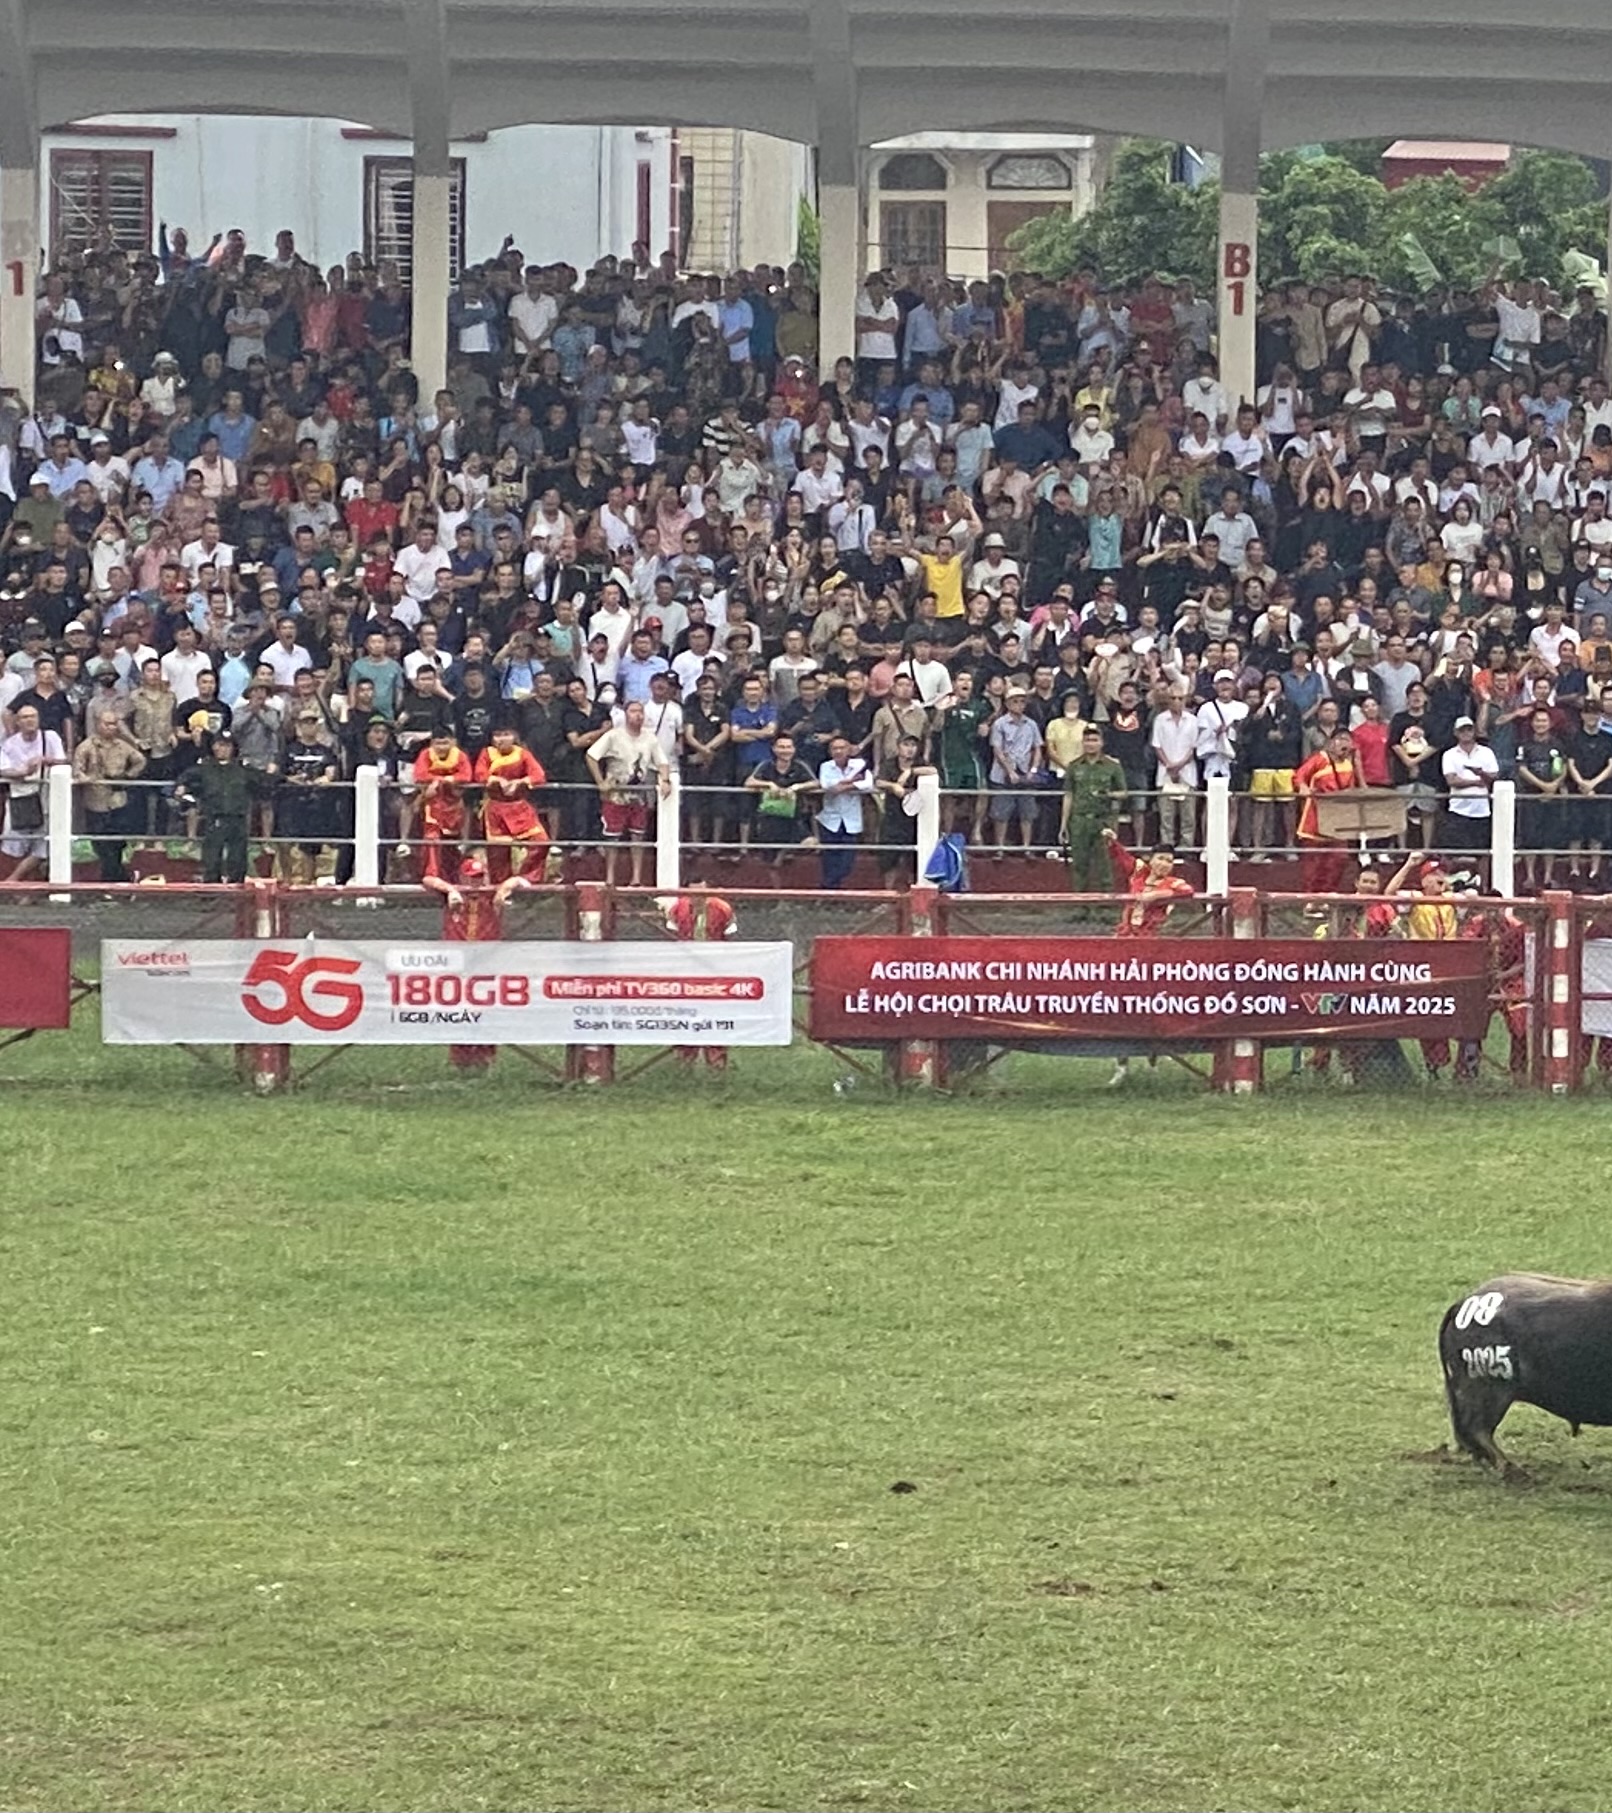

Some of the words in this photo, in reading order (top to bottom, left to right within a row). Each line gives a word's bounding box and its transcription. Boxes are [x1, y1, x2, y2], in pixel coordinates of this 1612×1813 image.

[5, 260, 24, 297] 1
[116, 951, 188, 966] viettel
[871, 961, 981, 981] AGRIBANK
[985, 961, 1022, 981] CHI
[1027, 958, 1105, 981] NHÁNH
[1110, 957, 1148, 981] HẢI
[1152, 959, 1230, 981] PHÒNG
[1304, 959, 1366, 982] HÀNH
[1370, 959, 1432, 983] CÙNG
[241, 949, 365, 1032] 5G
[386, 974, 531, 1007] 180GB
[623, 981, 682, 997] TV360
[683, 981, 729, 997] basic
[729, 981, 756, 997] 4K
[845, 987, 870, 1013] LỄ
[874, 990, 913, 1018] HỘI
[918, 993, 972, 1018] CHỌI
[974, 991, 1031, 1014] TRÂU
[1123, 990, 1200, 1014] THỐNG
[1241, 995, 1287, 1015] SƠN
[1350, 993, 1401, 1015] NĂM
[1404, 996, 1457, 1015] 2025
[1454, 1291, 1504, 1330] 08
[1462, 1345, 1514, 1380] 2025
